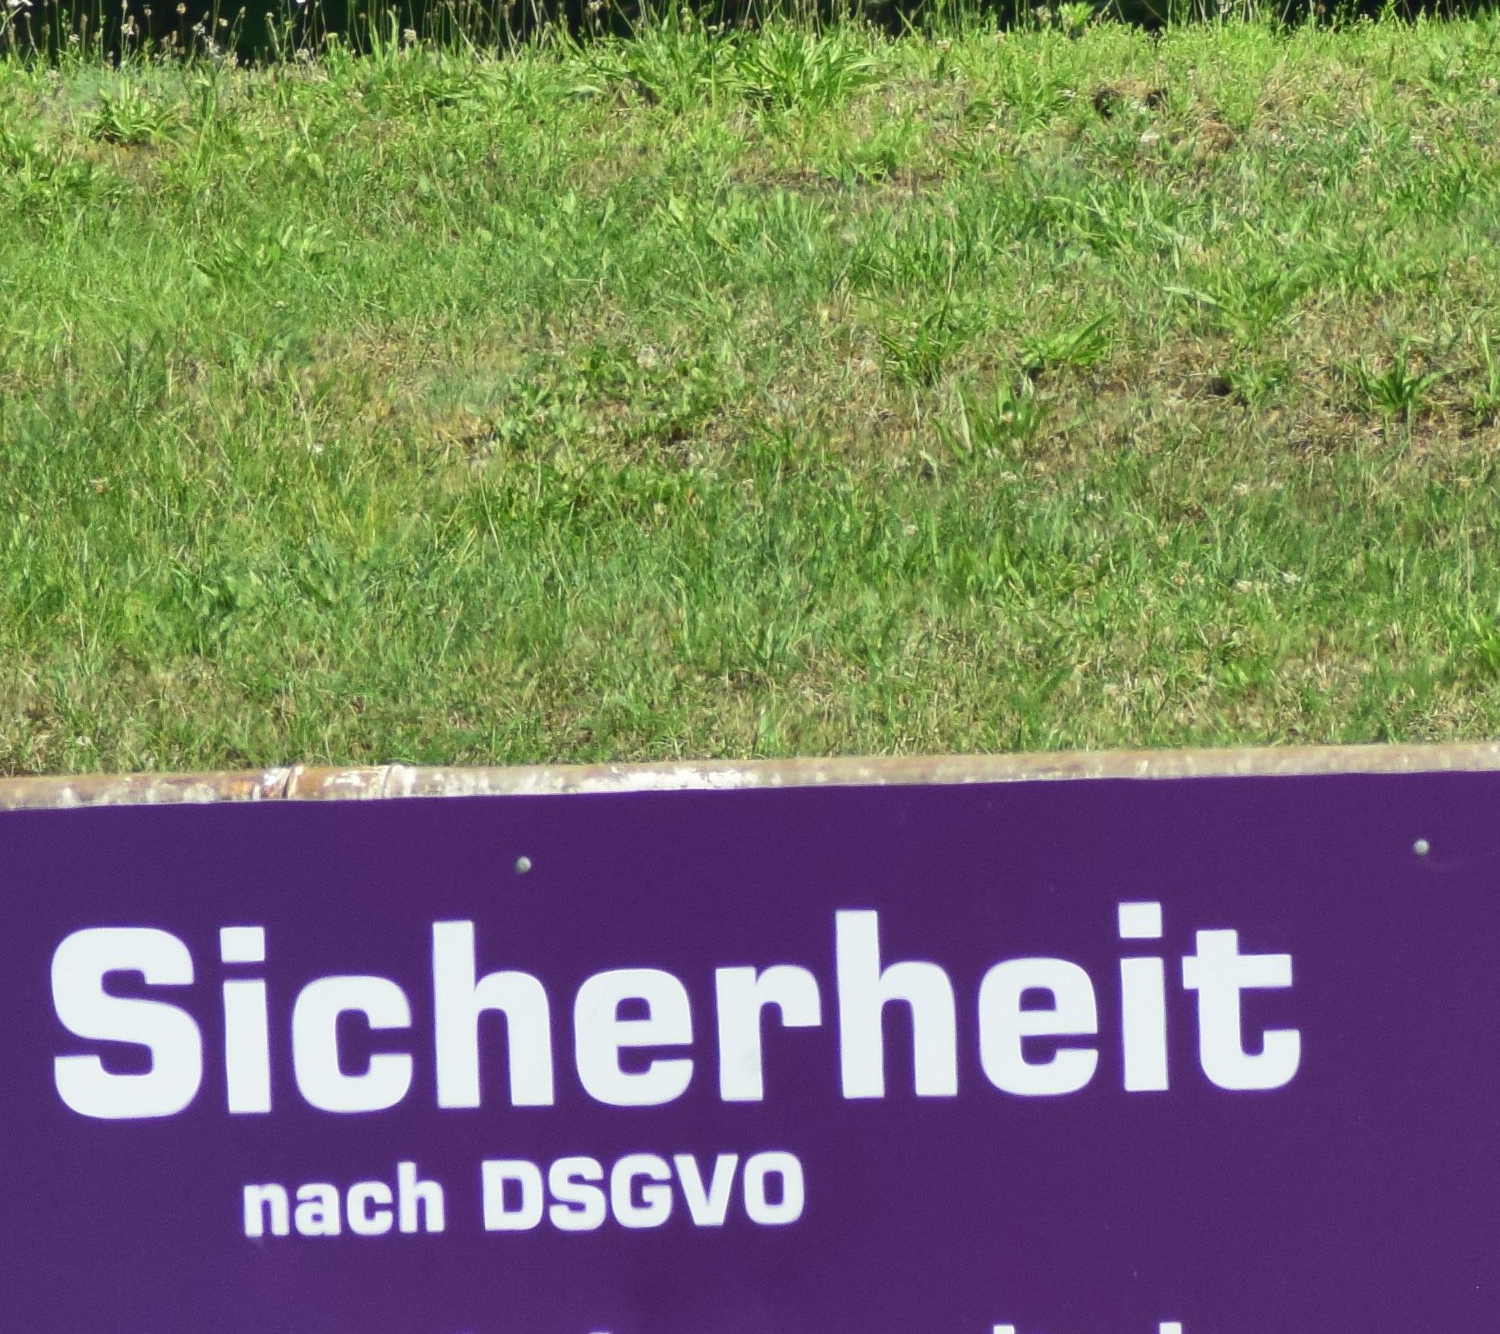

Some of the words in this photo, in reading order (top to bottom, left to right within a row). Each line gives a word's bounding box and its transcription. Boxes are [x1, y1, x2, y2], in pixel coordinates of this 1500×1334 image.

[49, 900, 1302, 1121] Sicherheit
[242, 1160, 446, 1239] nach
[480, 1150, 806, 1232] DSGVO
